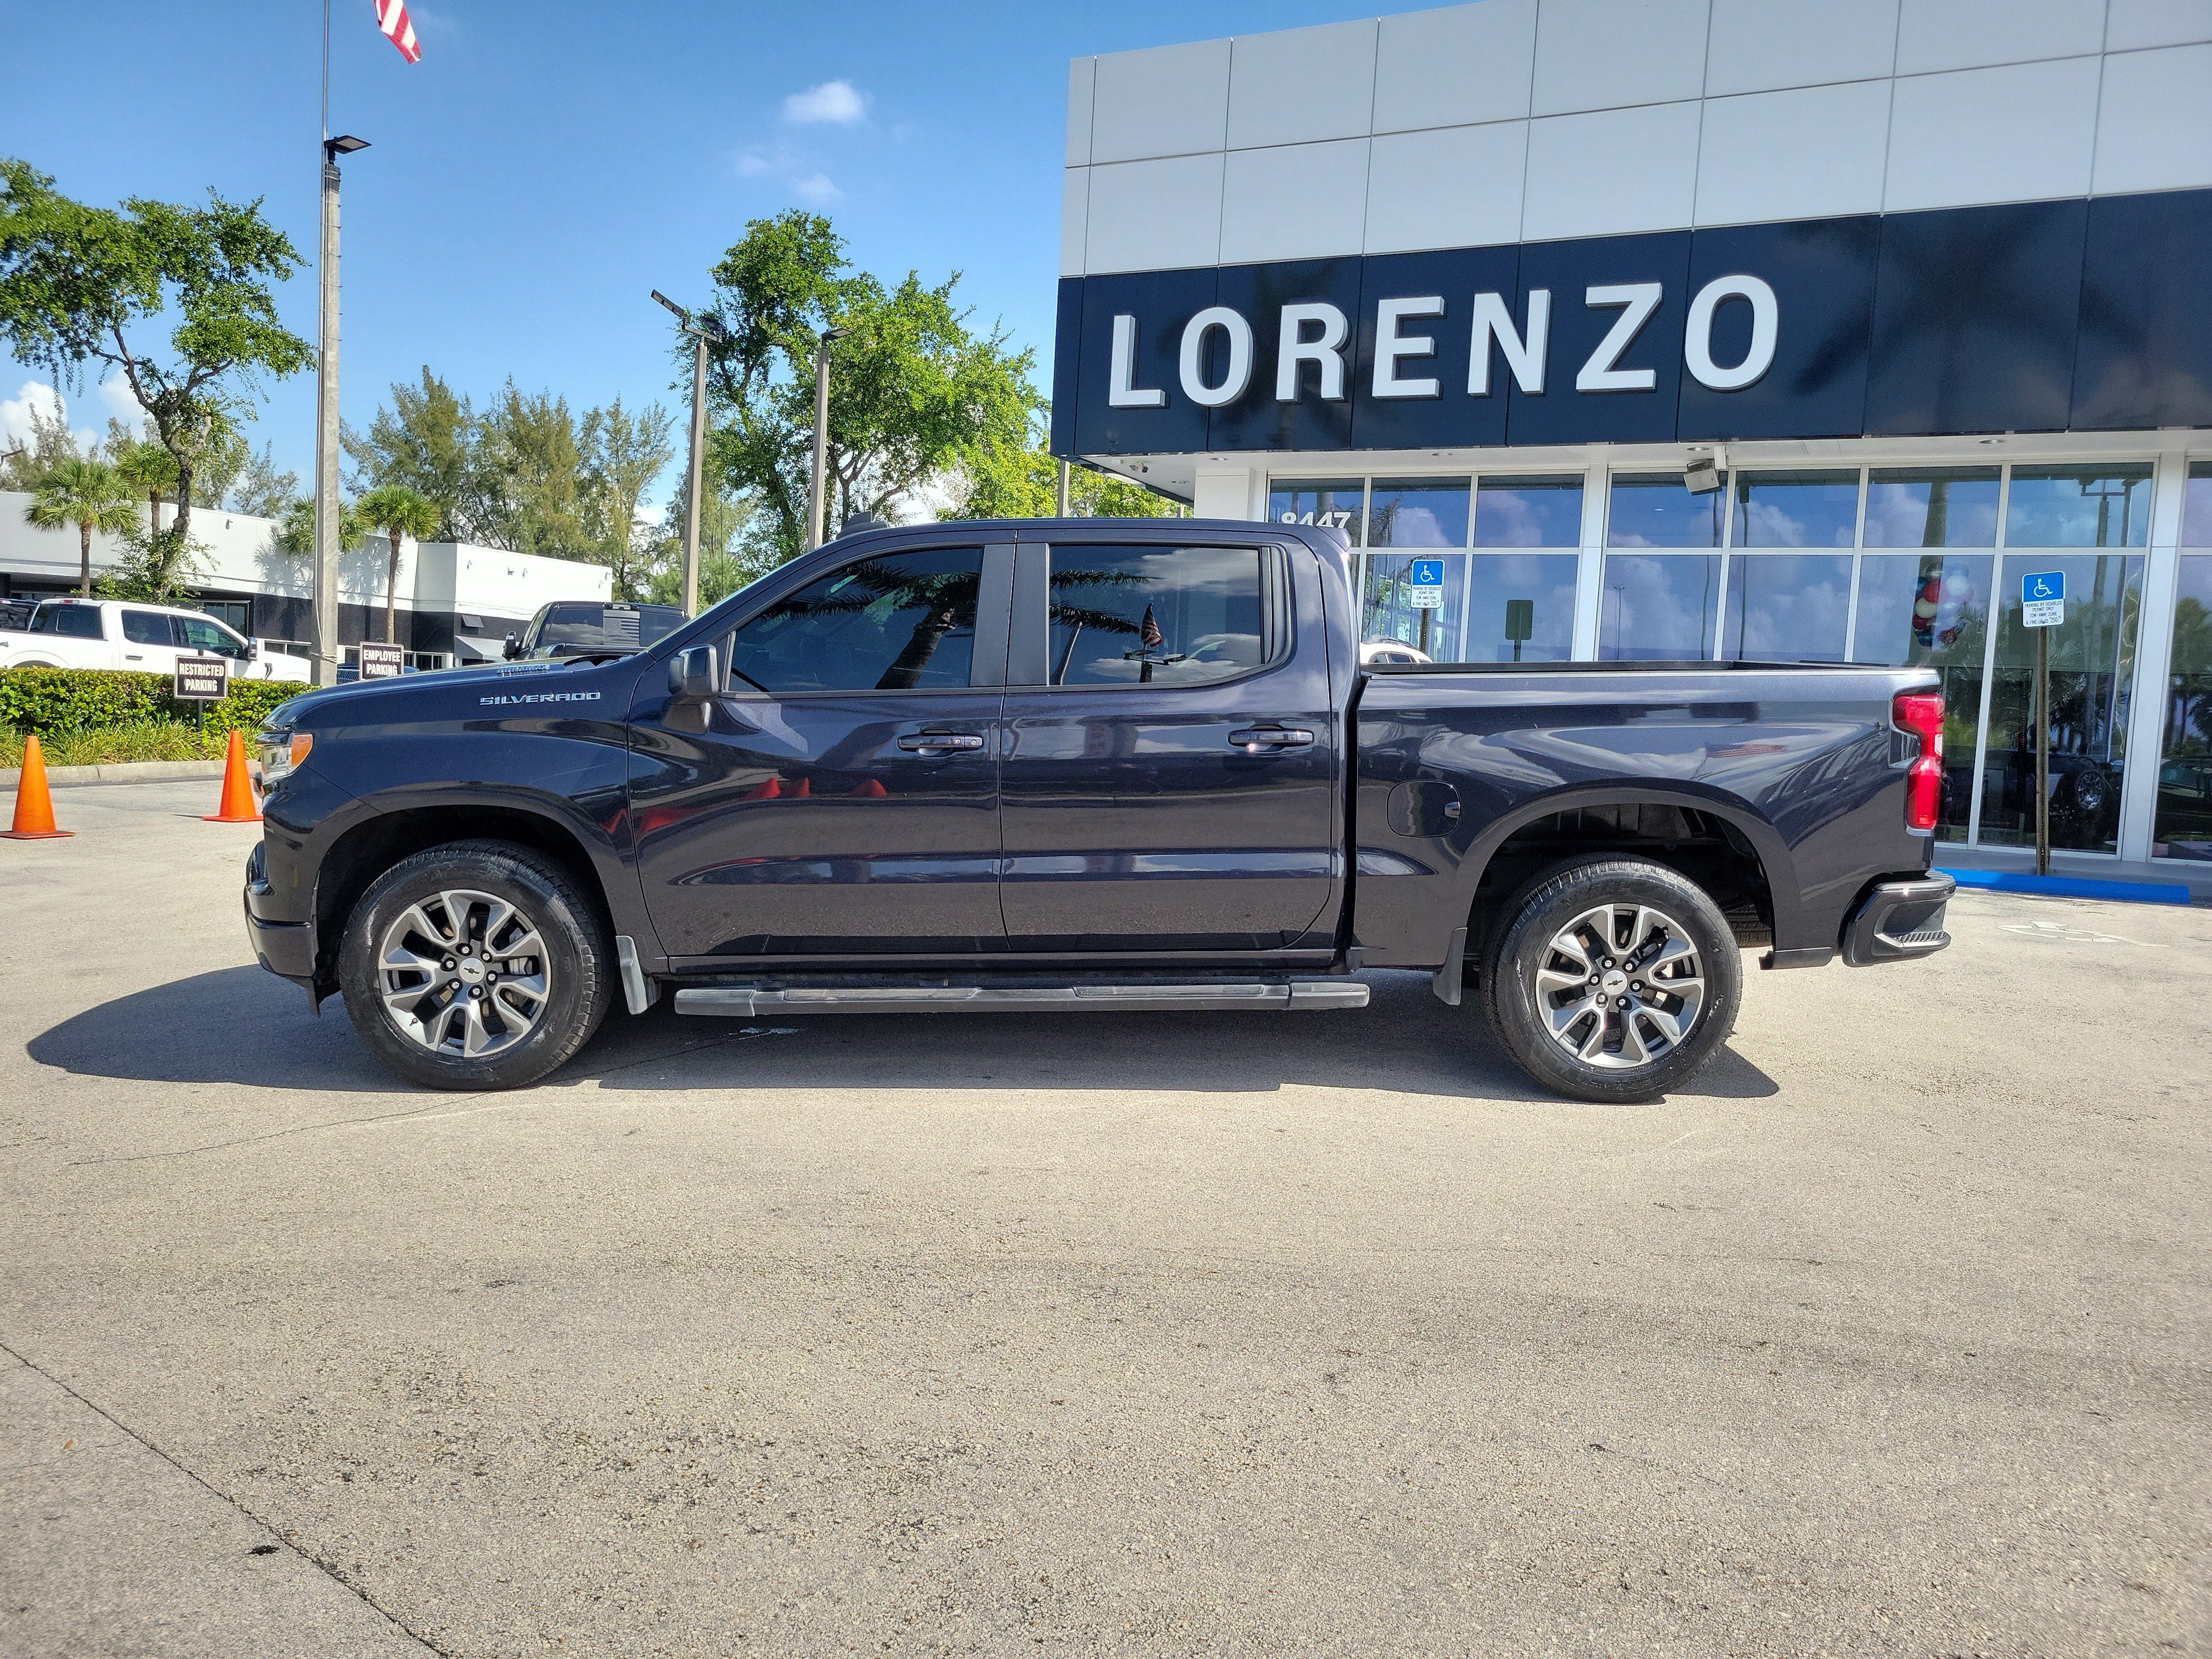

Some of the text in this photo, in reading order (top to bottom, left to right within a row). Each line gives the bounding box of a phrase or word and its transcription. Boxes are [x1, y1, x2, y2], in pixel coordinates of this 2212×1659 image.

[1108, 274, 1779, 408] LORENZO
[1282, 512, 1351, 528] 8447
[363, 649, 400, 662] EMPLOYEE
[179, 663, 224, 676] RESTRICTED
[366, 663, 398, 676] PARKING
[185, 679, 217, 692] PARKING
[479, 691, 601, 706] SILVERADO
